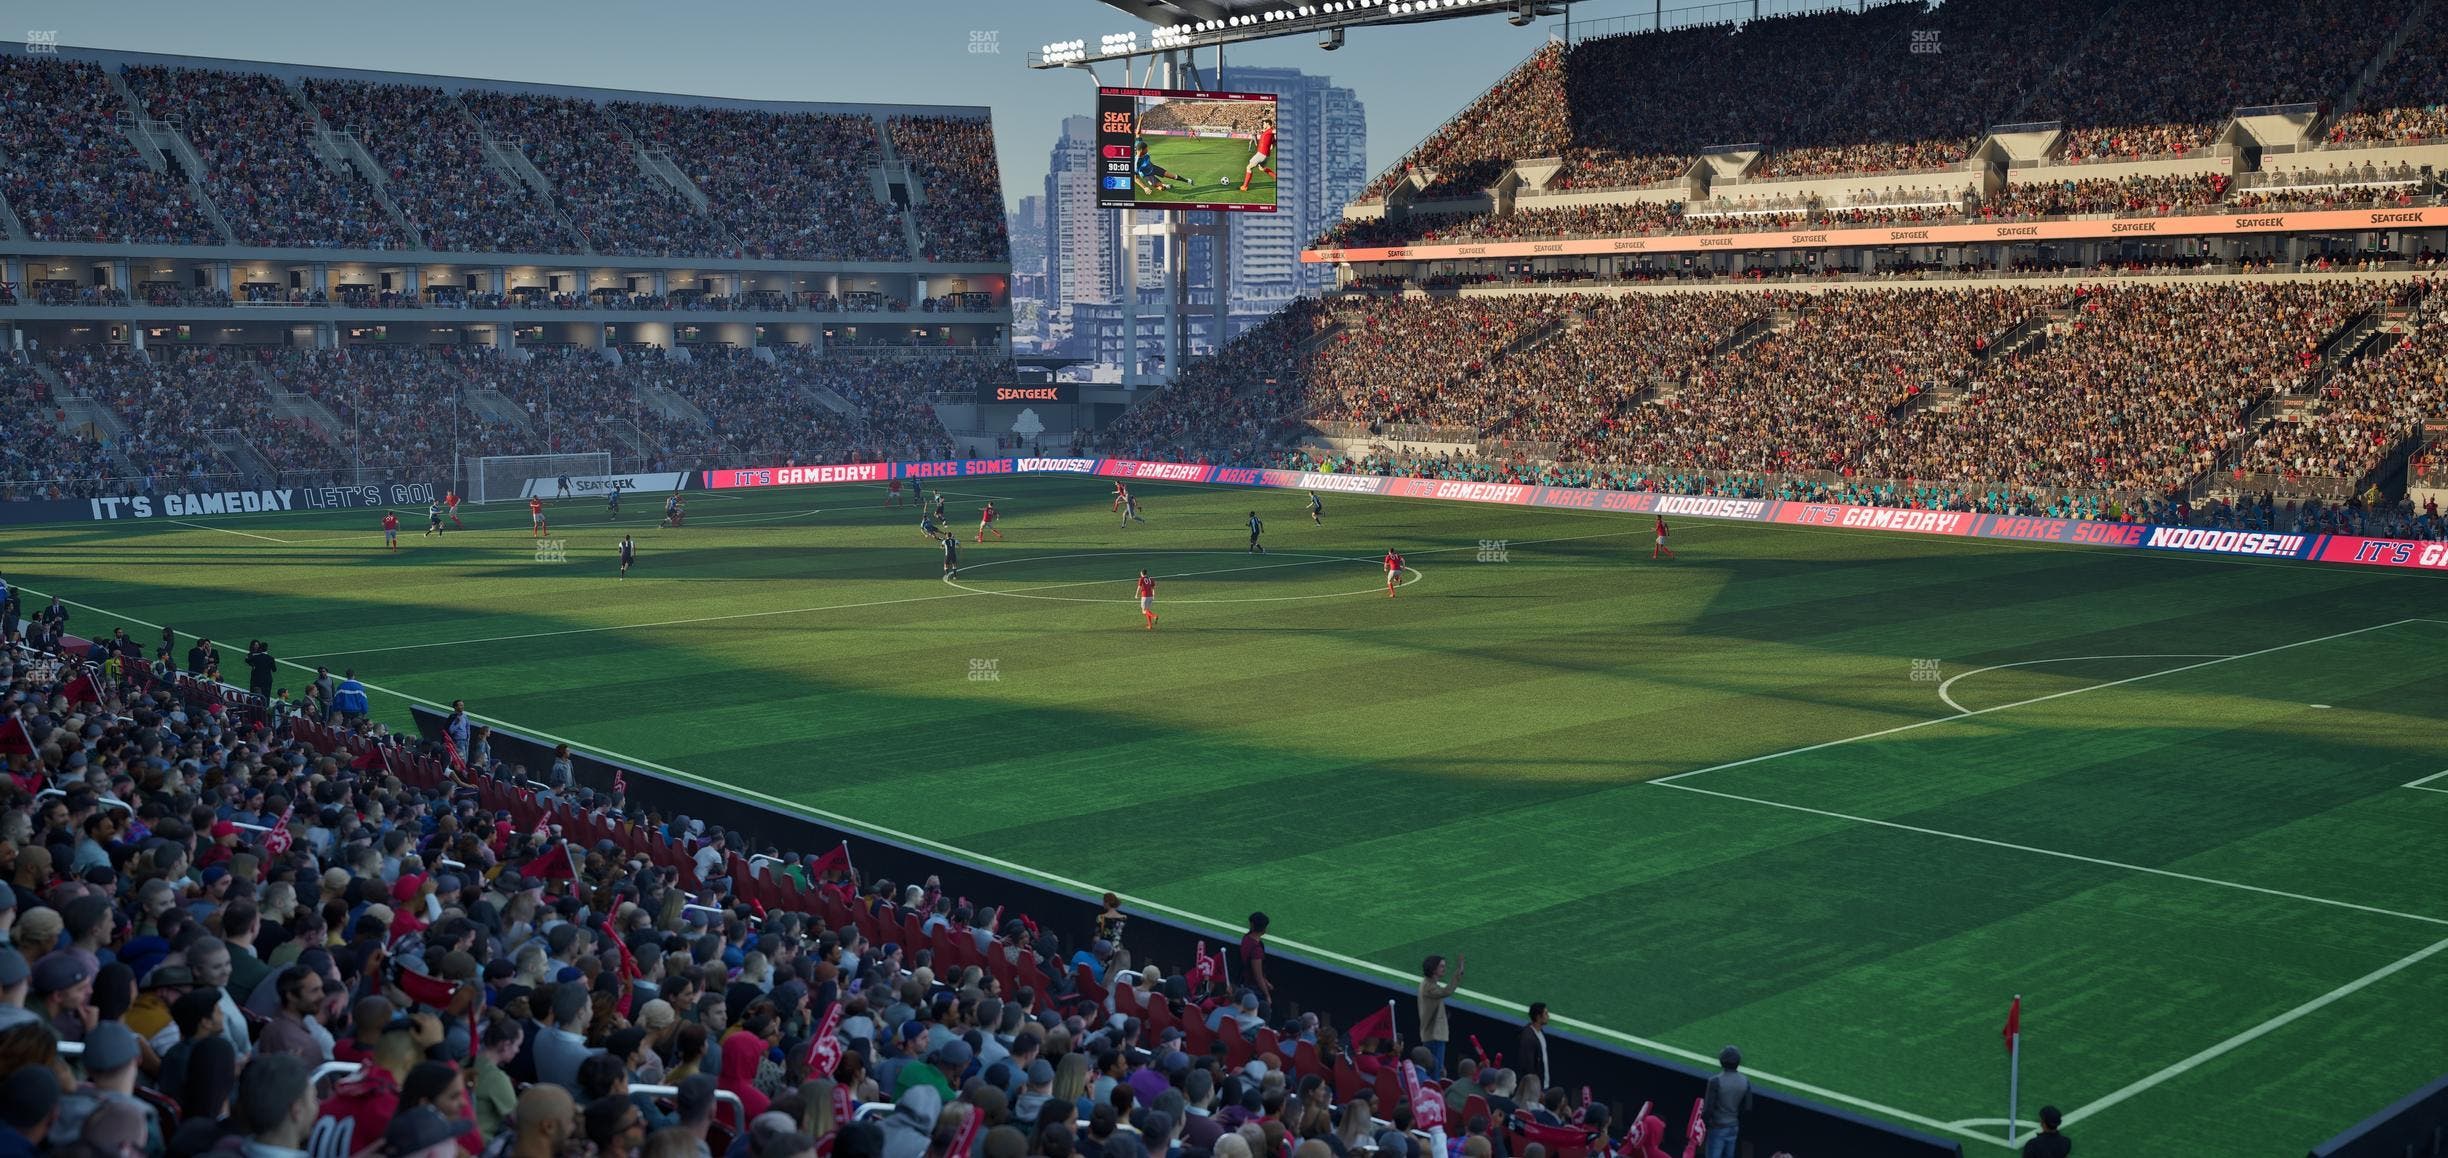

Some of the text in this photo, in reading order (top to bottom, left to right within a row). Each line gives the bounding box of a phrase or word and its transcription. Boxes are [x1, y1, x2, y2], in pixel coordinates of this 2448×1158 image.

[1104, 112, 1131, 123] SEAT
[1103, 123, 1132, 134] GEEK
[1108, 163, 1130, 171] 90:00
[2236, 218, 2284, 229] SEATGEEK
[2371, 213, 2424, 224] SEATGEEK
[1997, 226, 2038, 238] SEATGEEK
[2111, 222, 2157, 233] SEATGEEK
[1792, 234, 1828, 245] SEATGEEK
[1891, 230, 1929, 241] SEATGEEK
[1534, 245, 1563, 253] SEATGEEK
[1614, 241, 1646, 250] SEATGEEK
[1700, 238, 1734, 248] SEATGEEK
[1387, 250, 1414, 258] SEATGEEK
[1459, 247, 1486, 256] SEATGEEK
[997, 387, 1057, 400] SEATGEEK
[905, 461, 957, 478] MAKE
[965, 459, 1013, 475] SOME
[1112, 461, 1201, 480] IT'S GAMEDAY!
[735, 465, 877, 487] IT'S GAMEDAY!
[1215, 468, 1259, 483] MAKE
[1260, 472, 1298, 487] SOME
[576, 478, 636, 491] SEATGEEK
[303, 483, 434, 509] LET'S GO!
[1404, 480, 1522, 504] IT'S GAMEDAY!
[90, 489, 293, 520] IT'S GAMEDAY
[1544, 488, 1599, 508] MAKE
[1601, 493, 1655, 512] SOME
[1797, 505, 1961, 532] IT'S GAMEDAY!
[1991, 517, 2304, 556] MAKE SOME NOOOOISE!!!
[2355, 540, 2415, 564] IT'S
